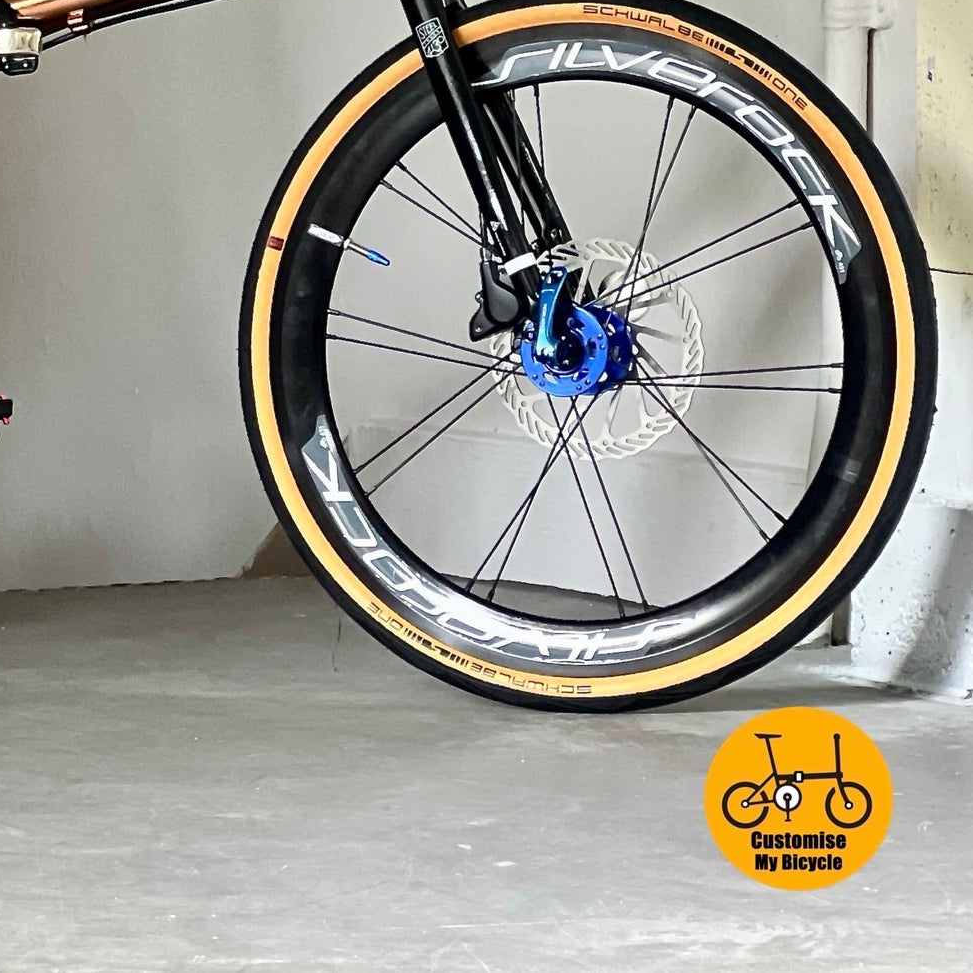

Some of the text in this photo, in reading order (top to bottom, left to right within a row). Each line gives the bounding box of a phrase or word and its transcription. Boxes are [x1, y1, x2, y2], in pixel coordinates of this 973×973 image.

[583, 4, 808, 112] SCHWALBE ONE
[366, 601, 593, 695] SCHWALBE ONE
